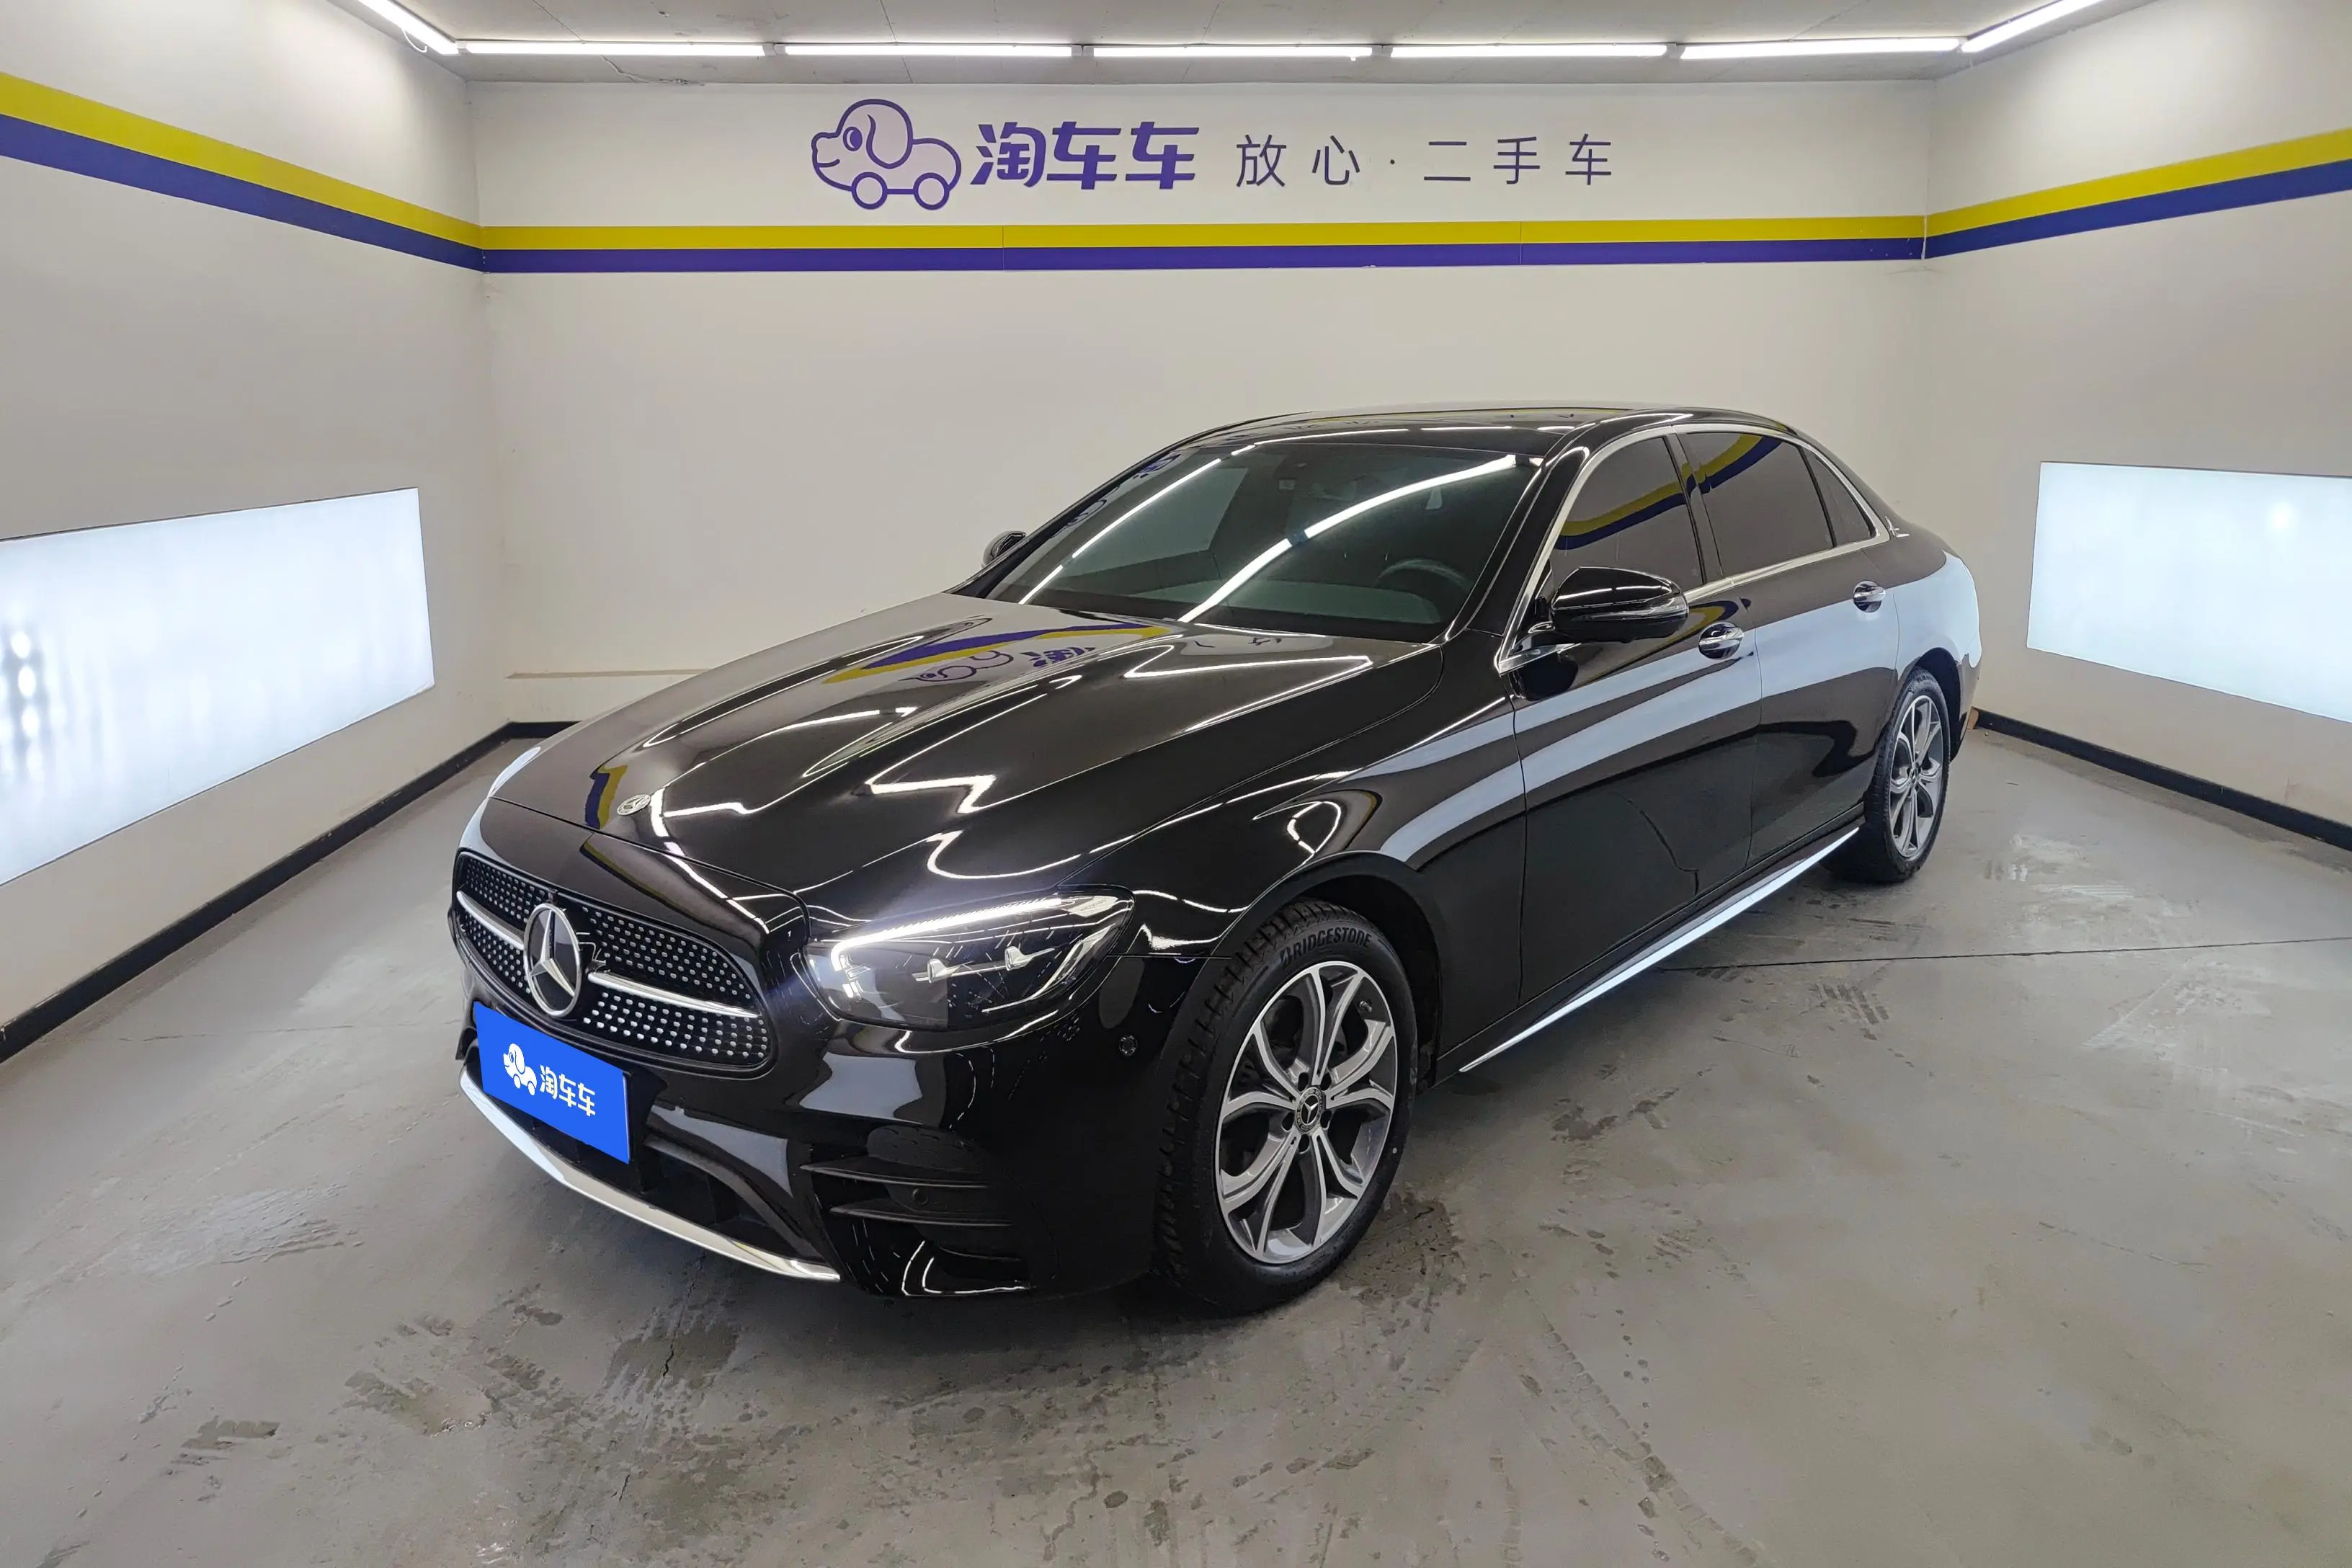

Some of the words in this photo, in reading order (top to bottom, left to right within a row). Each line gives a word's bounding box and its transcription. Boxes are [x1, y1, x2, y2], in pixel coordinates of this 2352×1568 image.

[970, 121, 1200, 190] 淘车车
[1279, 927, 1372, 966] BRIDGESTONE
